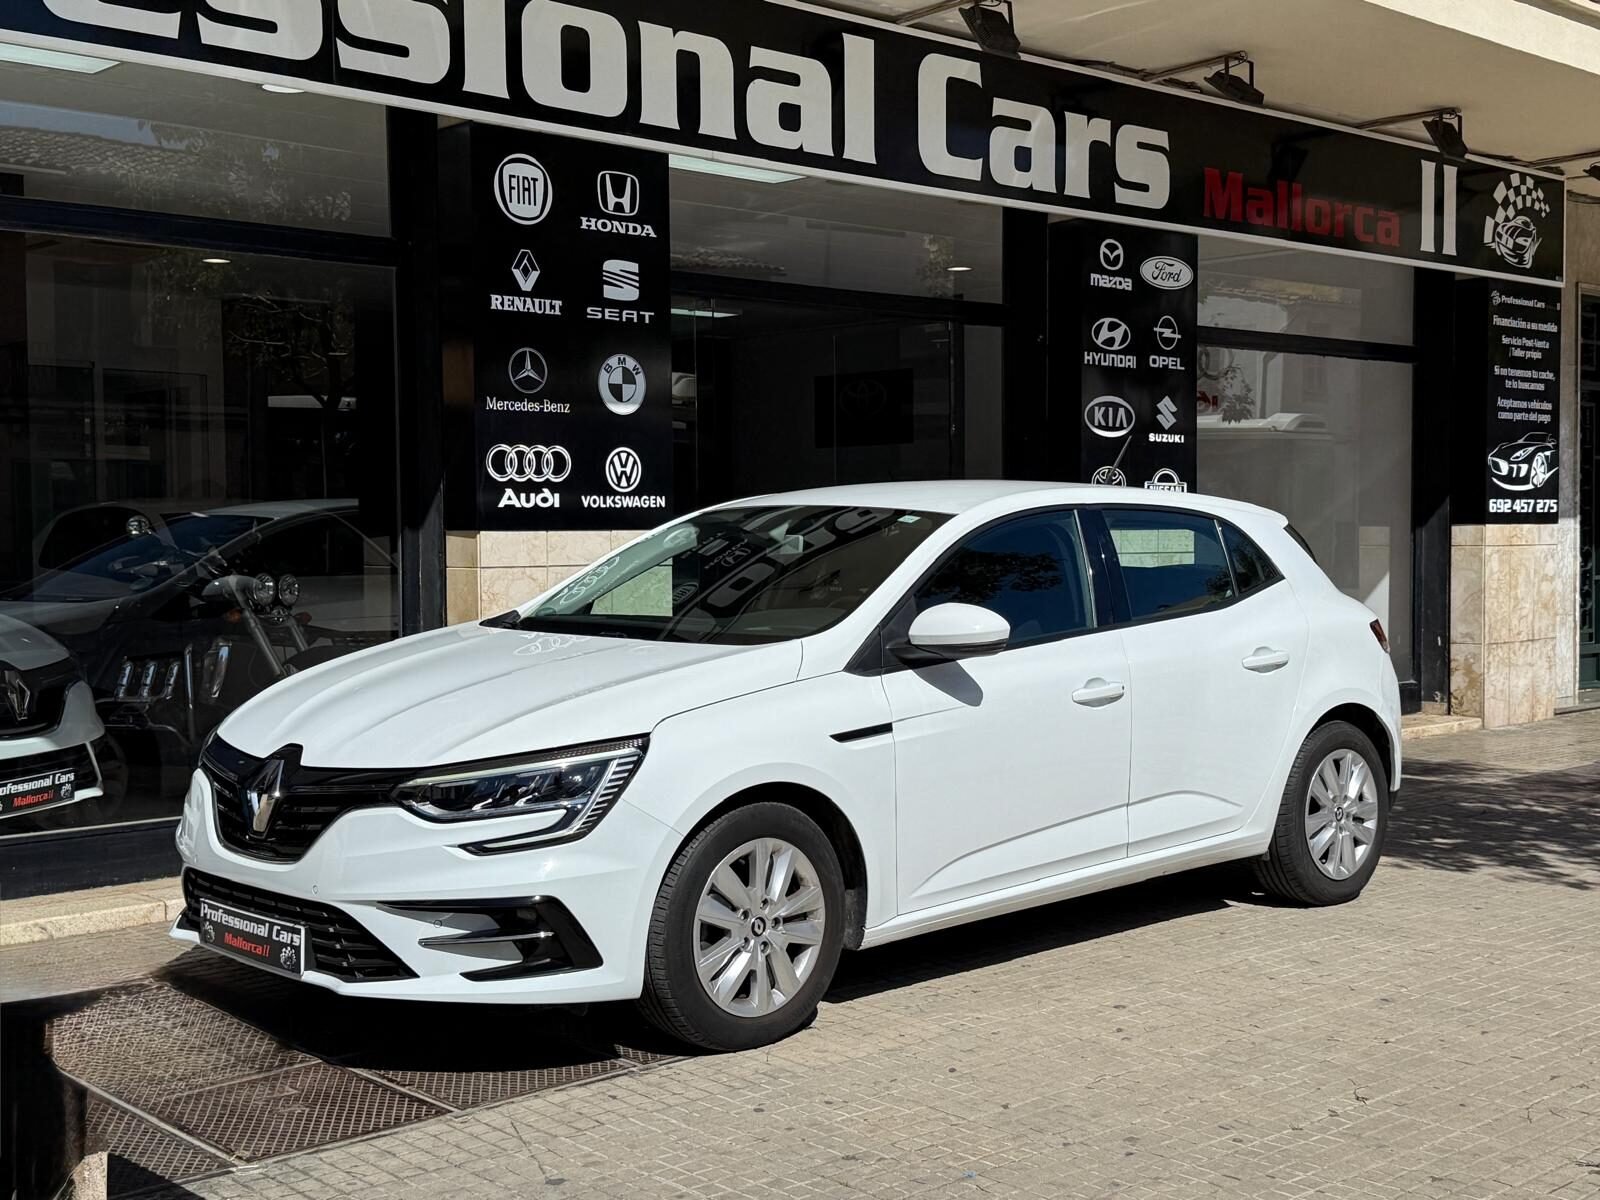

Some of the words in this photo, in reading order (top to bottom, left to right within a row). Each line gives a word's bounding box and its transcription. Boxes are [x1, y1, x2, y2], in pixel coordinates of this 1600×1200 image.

[917, 52, 1171, 210] Cars
[1203, 166, 1400, 248] Mallorca
[508, 174, 539, 207] FIAT
[580, 216, 657, 238] HONDA
[1151, 260, 1182, 283] Ford
[490, 294, 562, 316] RENAULT
[1501, 295, 1534, 307] Professional
[1534, 300, 1545, 309] Cars
[586, 306, 655, 324] SEAT
[1538, 322, 1558, 333] medida
[1501, 334, 1522, 346] Servicio
[1084, 351, 1136, 369] HYUNDAI
[1525, 349, 1542, 360] propio
[604, 356, 642, 376] BMW
[1149, 355, 1185, 370] OPEL
[1494, 365, 1500, 375] Si
[1500, 368, 1507, 376] no
[1507, 368, 1532, 378] tenemos
[1505, 379, 1512, 388] te
[1518, 380, 1544, 391] buscamos
[485, 396, 570, 413] Mercedes-Benz
[1497, 396, 1527, 410] Aceptamos
[1094, 406, 1128, 428] KIA
[1498, 411, 1513, 420] como
[1513, 412, 1529, 422] parte
[1529, 412, 1537, 421] del
[1537, 414, 1551, 424] pago
[1148, 433, 1185, 443] SUZUKI
[581, 495, 666, 508] VOLKSWAGEN
[1489, 499, 1512, 513] 692
[1512, 499, 1535, 513] 457
[1536, 499, 1558, 513] 275
[55, 773, 75, 784] Cars
[14, 793, 48, 807] Mallorca
[201, 902, 269, 937] Professional
[272, 925, 301, 946] Cars
[224, 933, 262, 955] Mallorca
